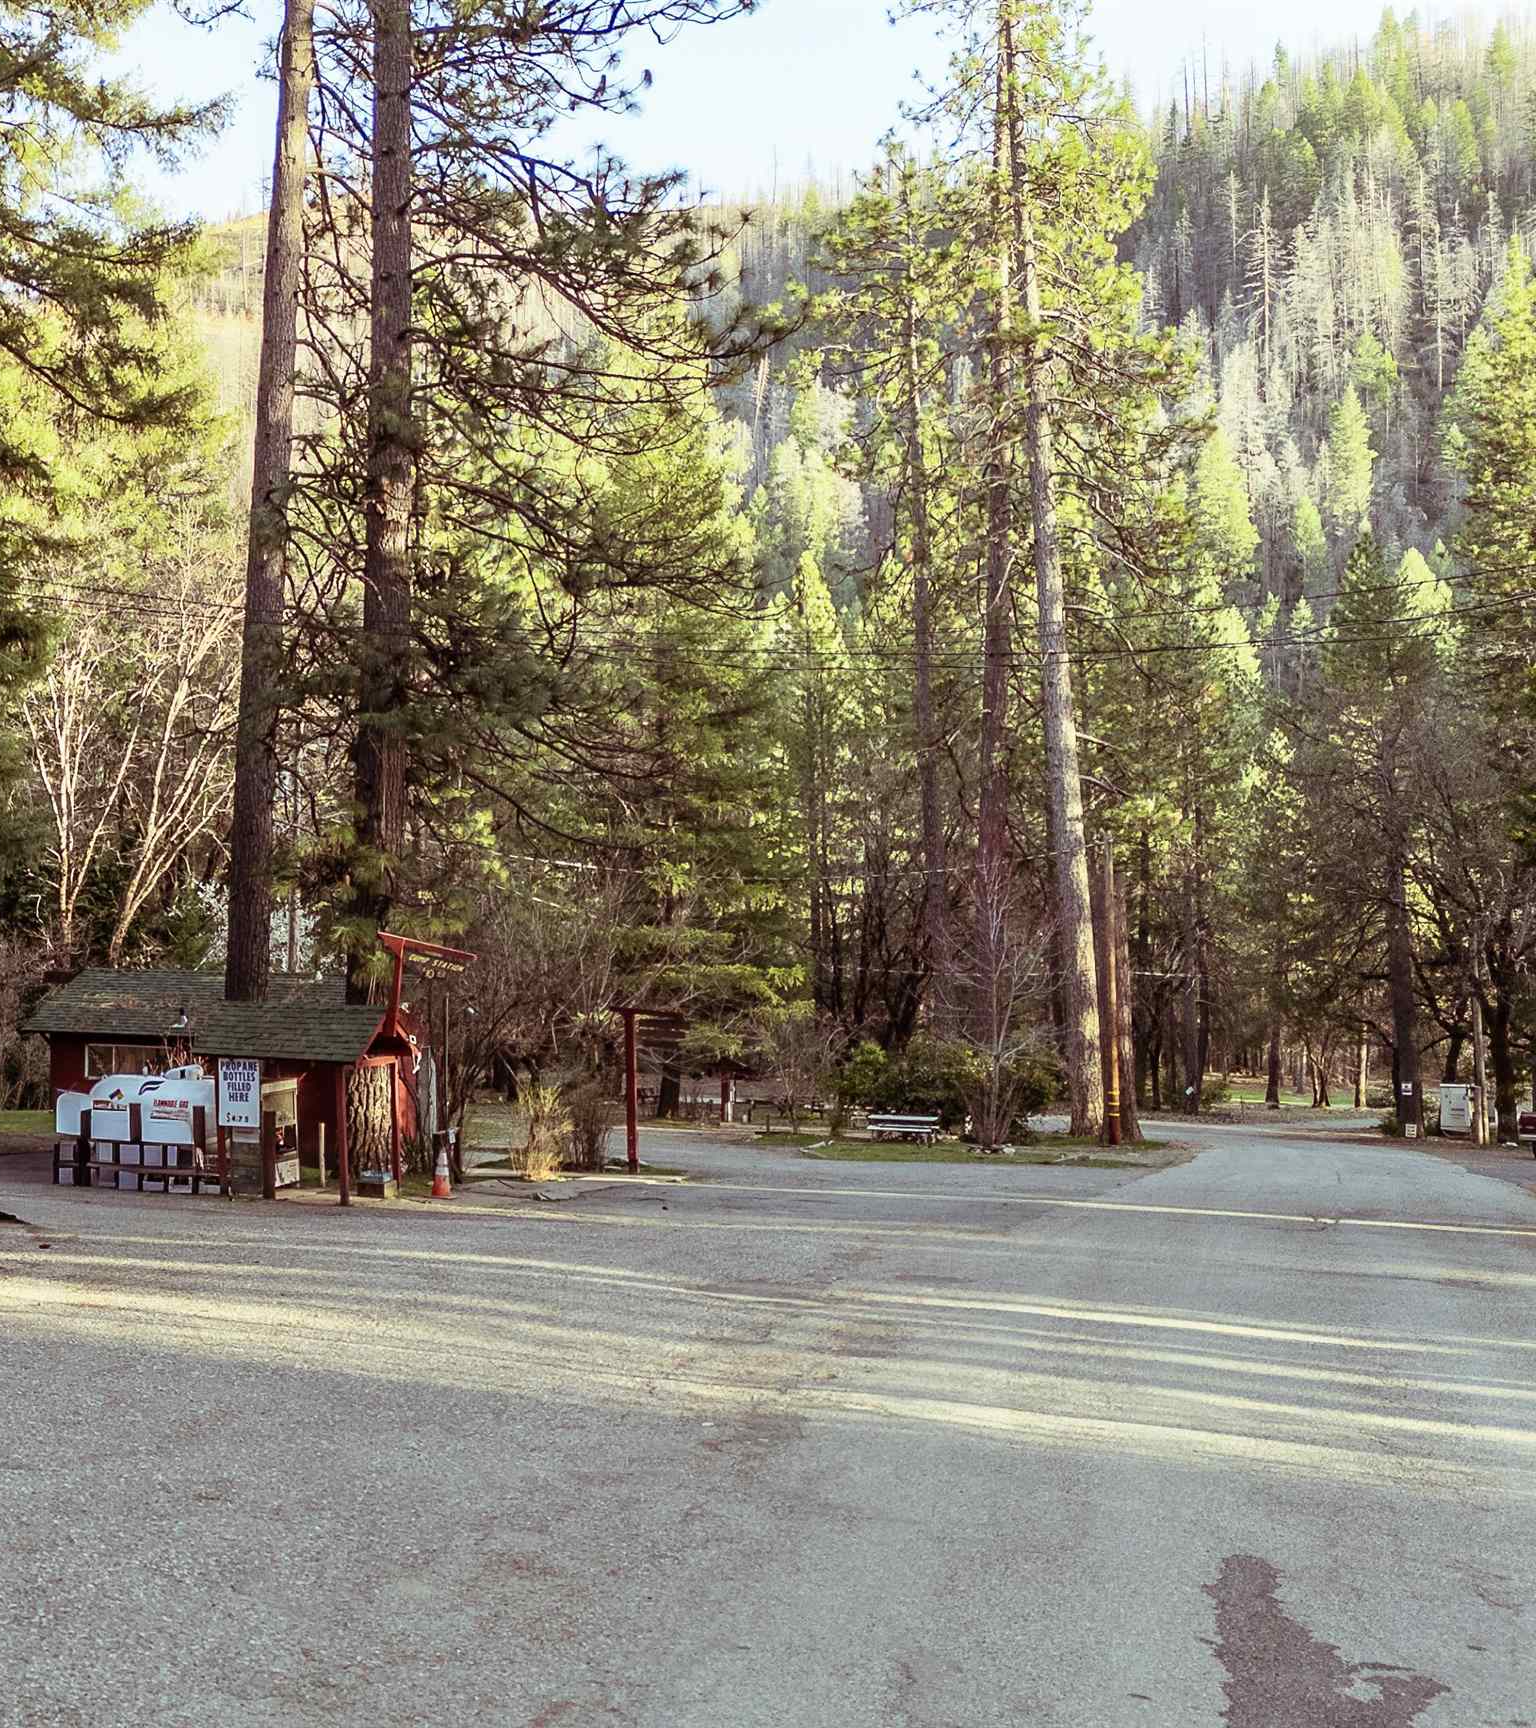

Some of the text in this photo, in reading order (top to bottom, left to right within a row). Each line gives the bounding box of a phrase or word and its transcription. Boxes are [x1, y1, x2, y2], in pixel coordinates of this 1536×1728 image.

[432, 959, 465, 973] STATION
[221, 1061, 257, 1072] PROPANE
[223, 1072, 255, 1082] BOTTLES
[227, 1082, 251, 1092] FILLED
[228, 1092, 249, 1102] HERE
